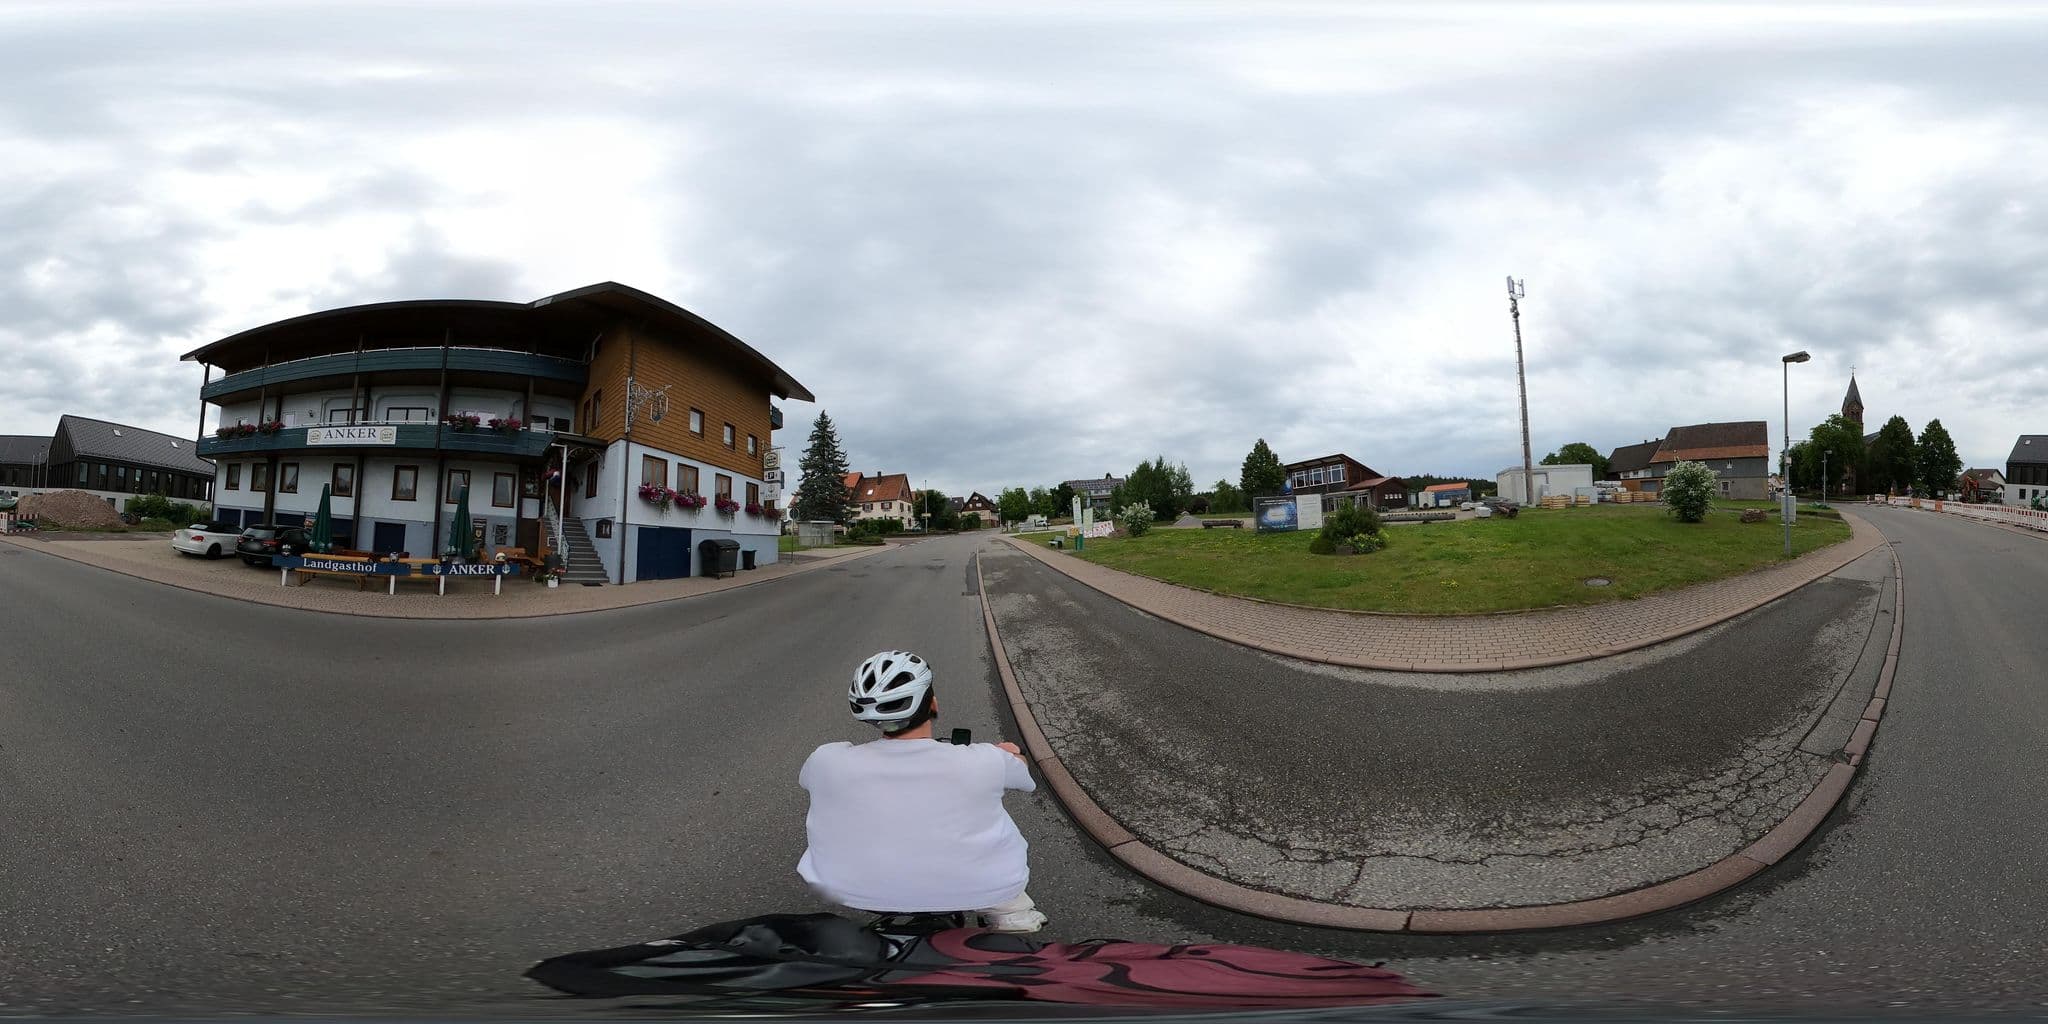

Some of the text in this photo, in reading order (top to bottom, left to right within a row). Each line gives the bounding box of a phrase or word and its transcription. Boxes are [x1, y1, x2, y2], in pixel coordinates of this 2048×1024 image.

[324, 427, 377, 439] ANKER
[303, 558, 377, 573] Landgasthof
[448, 564, 495, 575] ANKER
